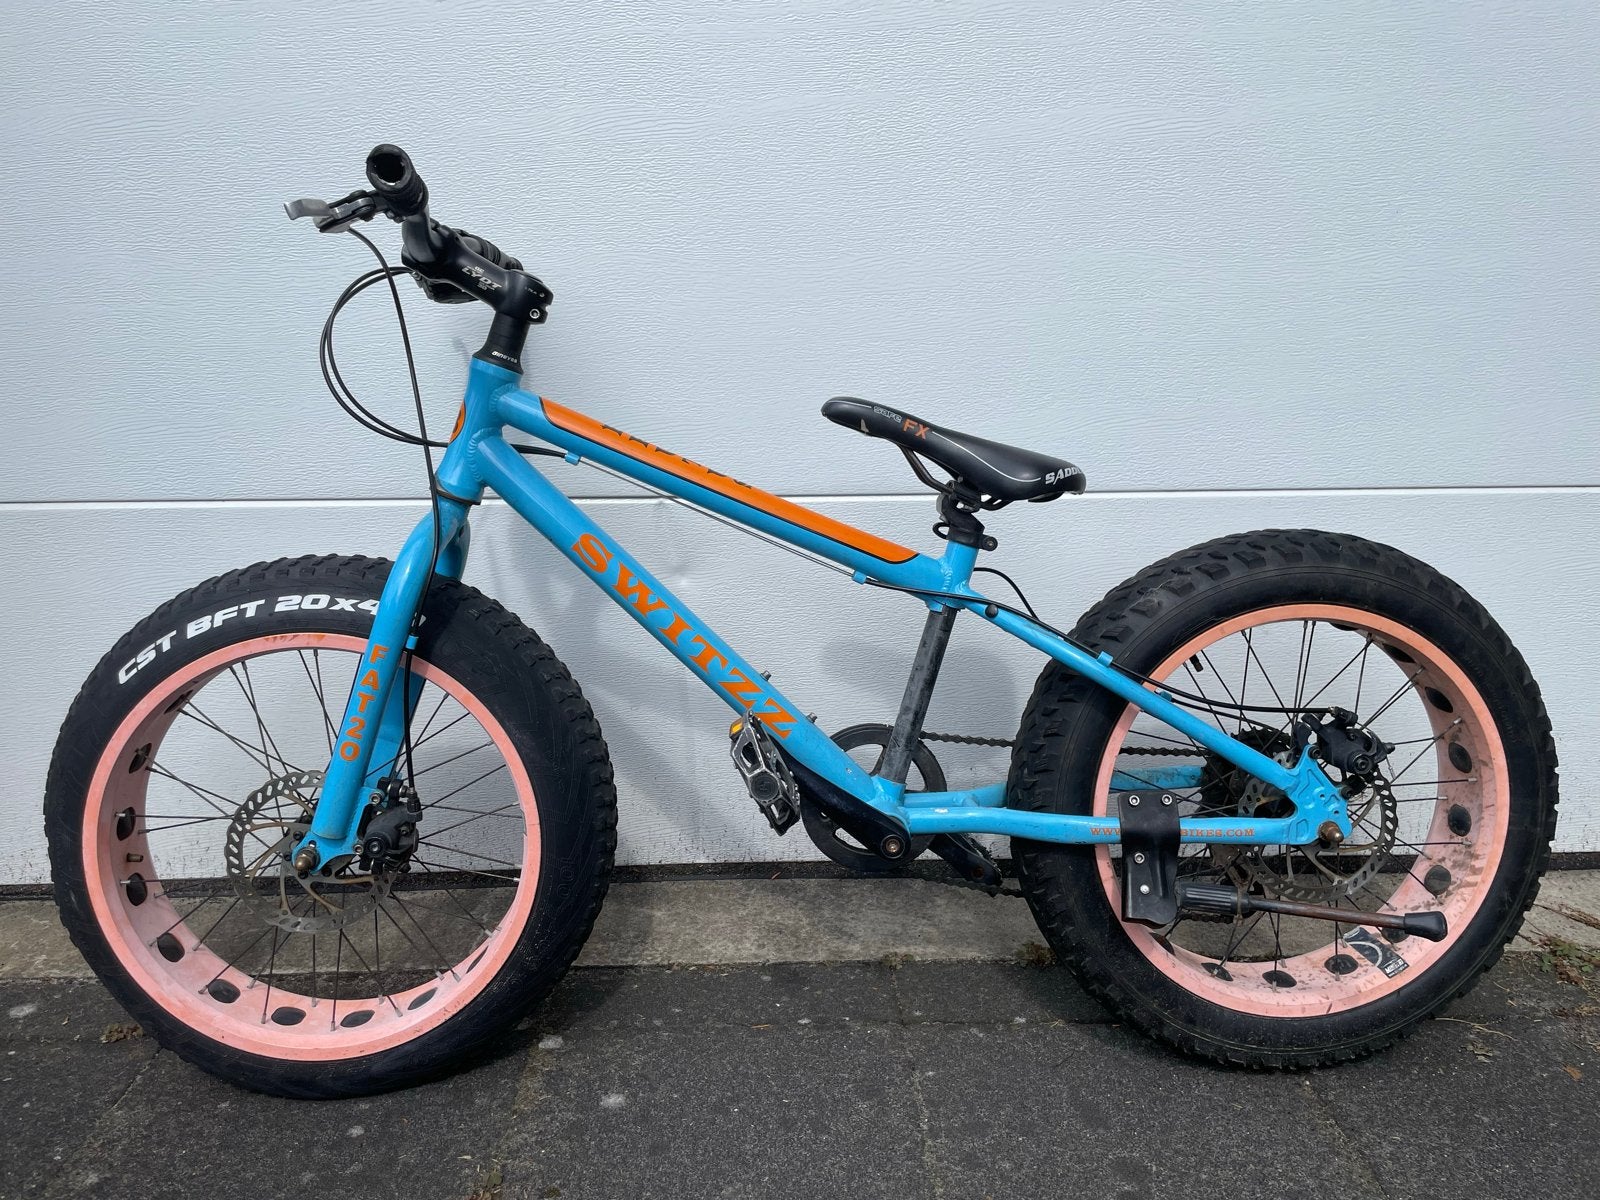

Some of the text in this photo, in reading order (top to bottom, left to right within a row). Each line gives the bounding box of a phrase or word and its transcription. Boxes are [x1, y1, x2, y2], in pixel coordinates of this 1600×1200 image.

[903, 418, 930, 440] FX
[117, 630, 178, 686] CST
[186, 598, 266, 640] BFT
[571, 532, 799, 740] SWITZZ
